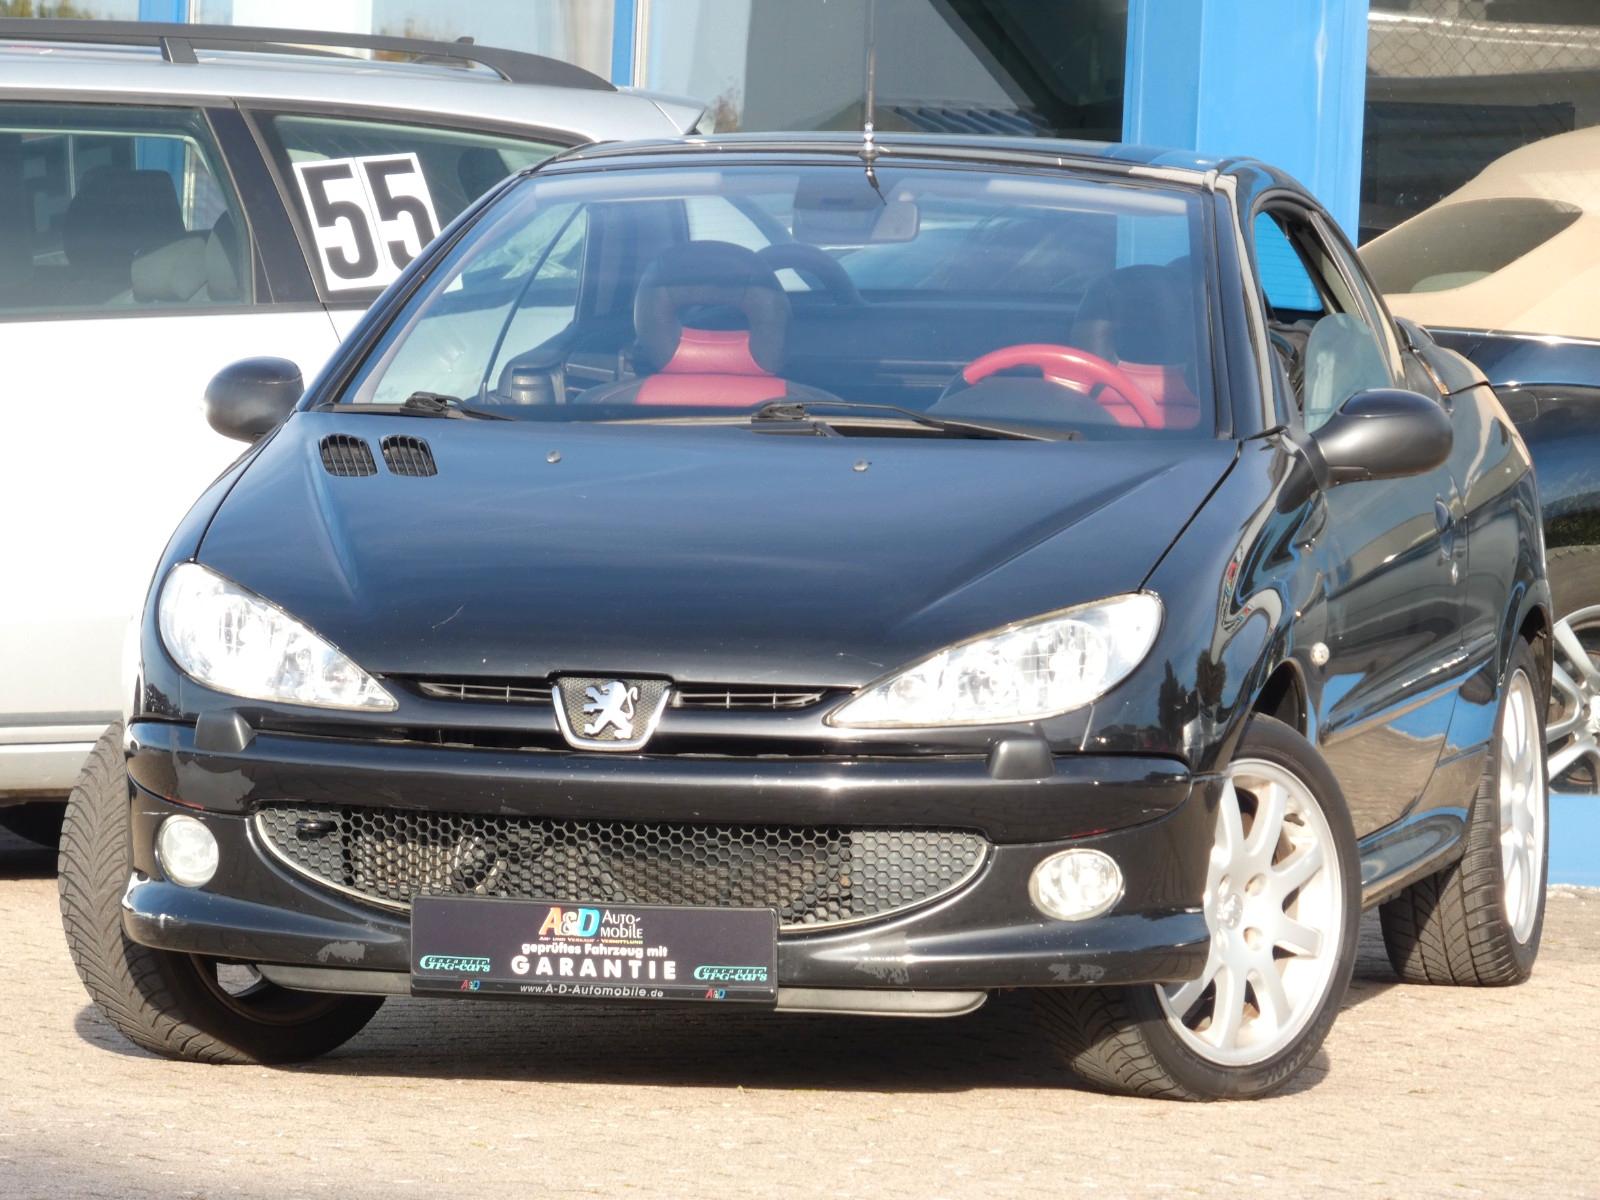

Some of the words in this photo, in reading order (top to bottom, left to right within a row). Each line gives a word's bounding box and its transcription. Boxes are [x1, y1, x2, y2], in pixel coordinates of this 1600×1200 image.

[300, 158, 436, 280] 55
[538, 906, 600, 937] A&D
[521, 942, 581, 955] geprüftes
[584, 944, 643, 959] Fahrzeug
[646, 945, 668, 957] mit
[511, 955, 676, 980] GARANTIE
[520, 984, 664, 998] www.A-D-Automobile.de
